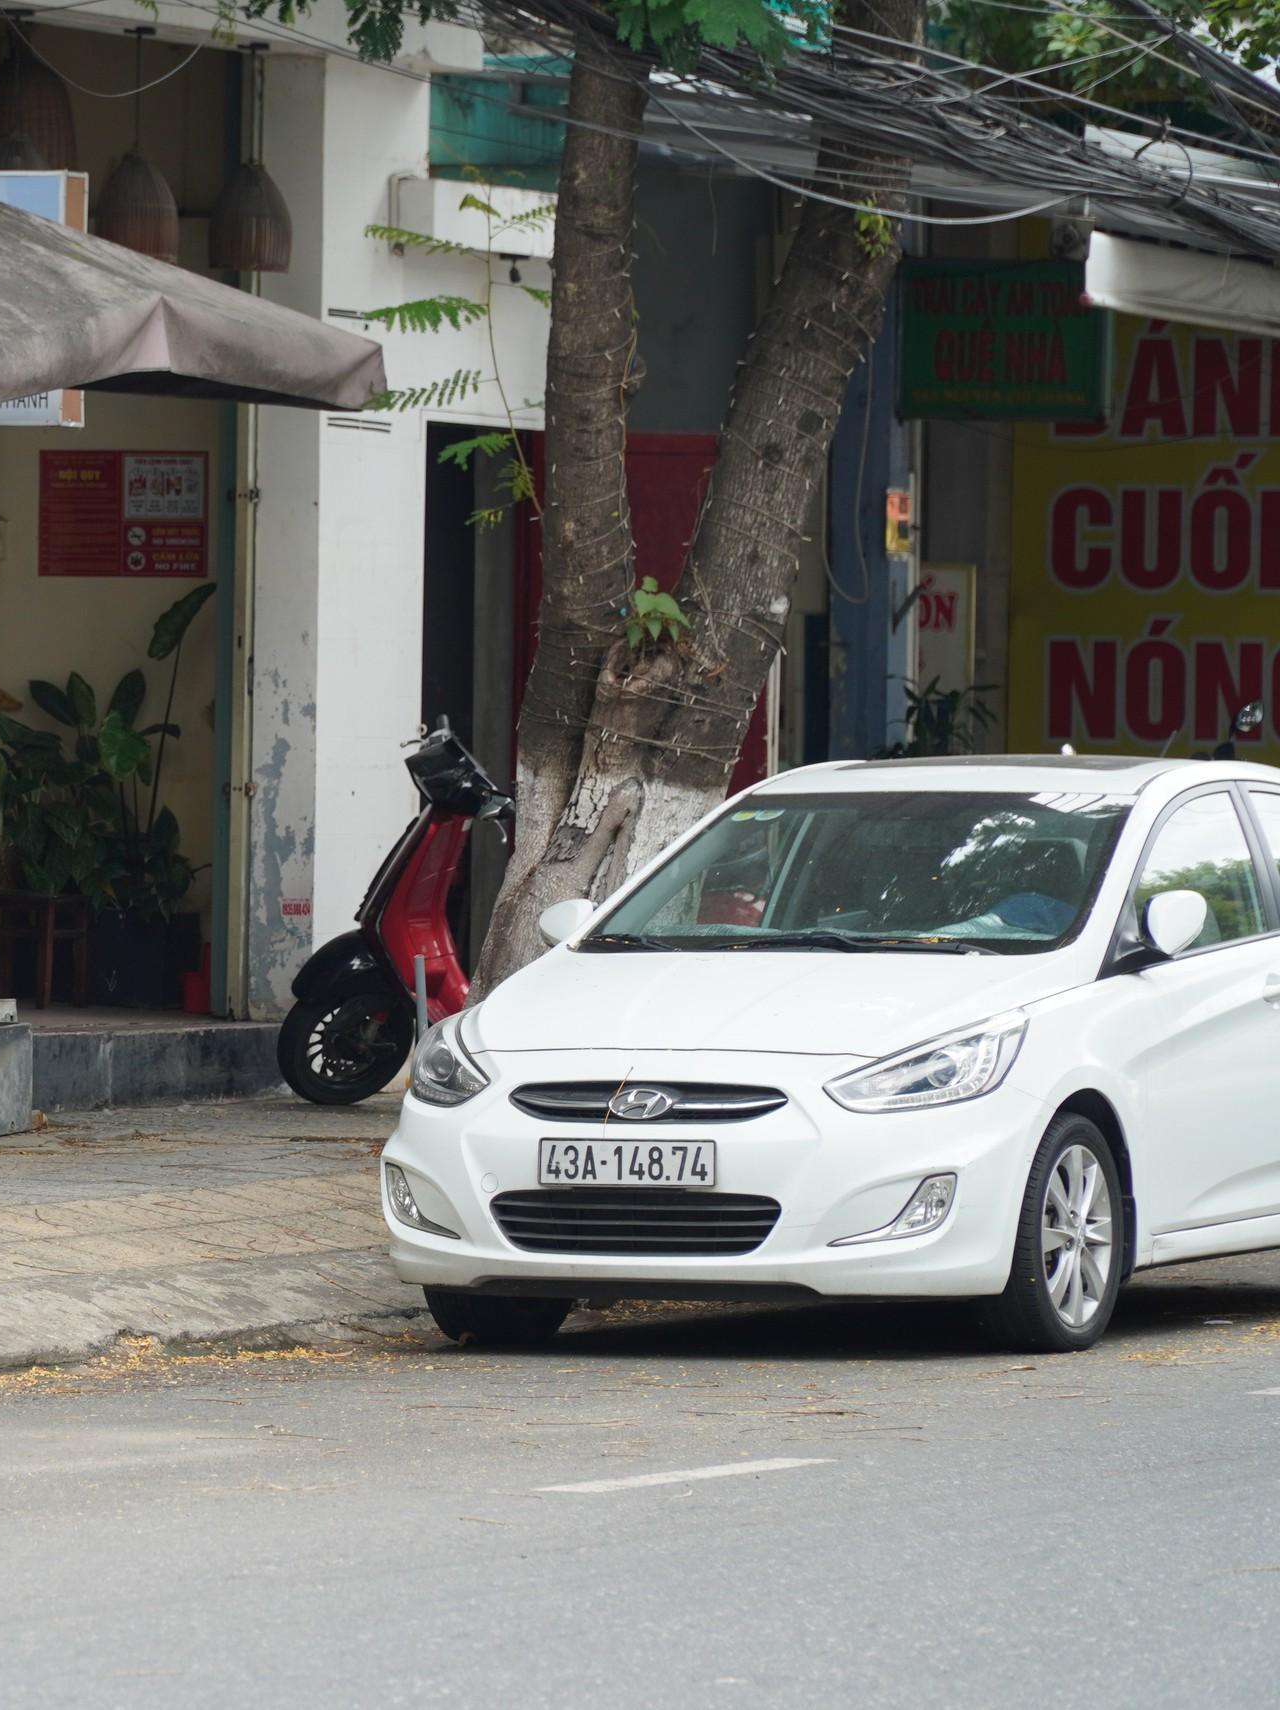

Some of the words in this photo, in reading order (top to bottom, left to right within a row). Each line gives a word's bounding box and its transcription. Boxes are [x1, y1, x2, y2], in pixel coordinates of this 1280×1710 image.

[1004, 319, 1066, 384] NHÀ
[1055, 319, 1280, 438] ÁN
[154, 562, 170, 570] NO
[172, 562, 198, 570] FIRE
[1048, 619, 1280, 744] NÓN
[546, 1144, 709, 1182] 43A-148.74
